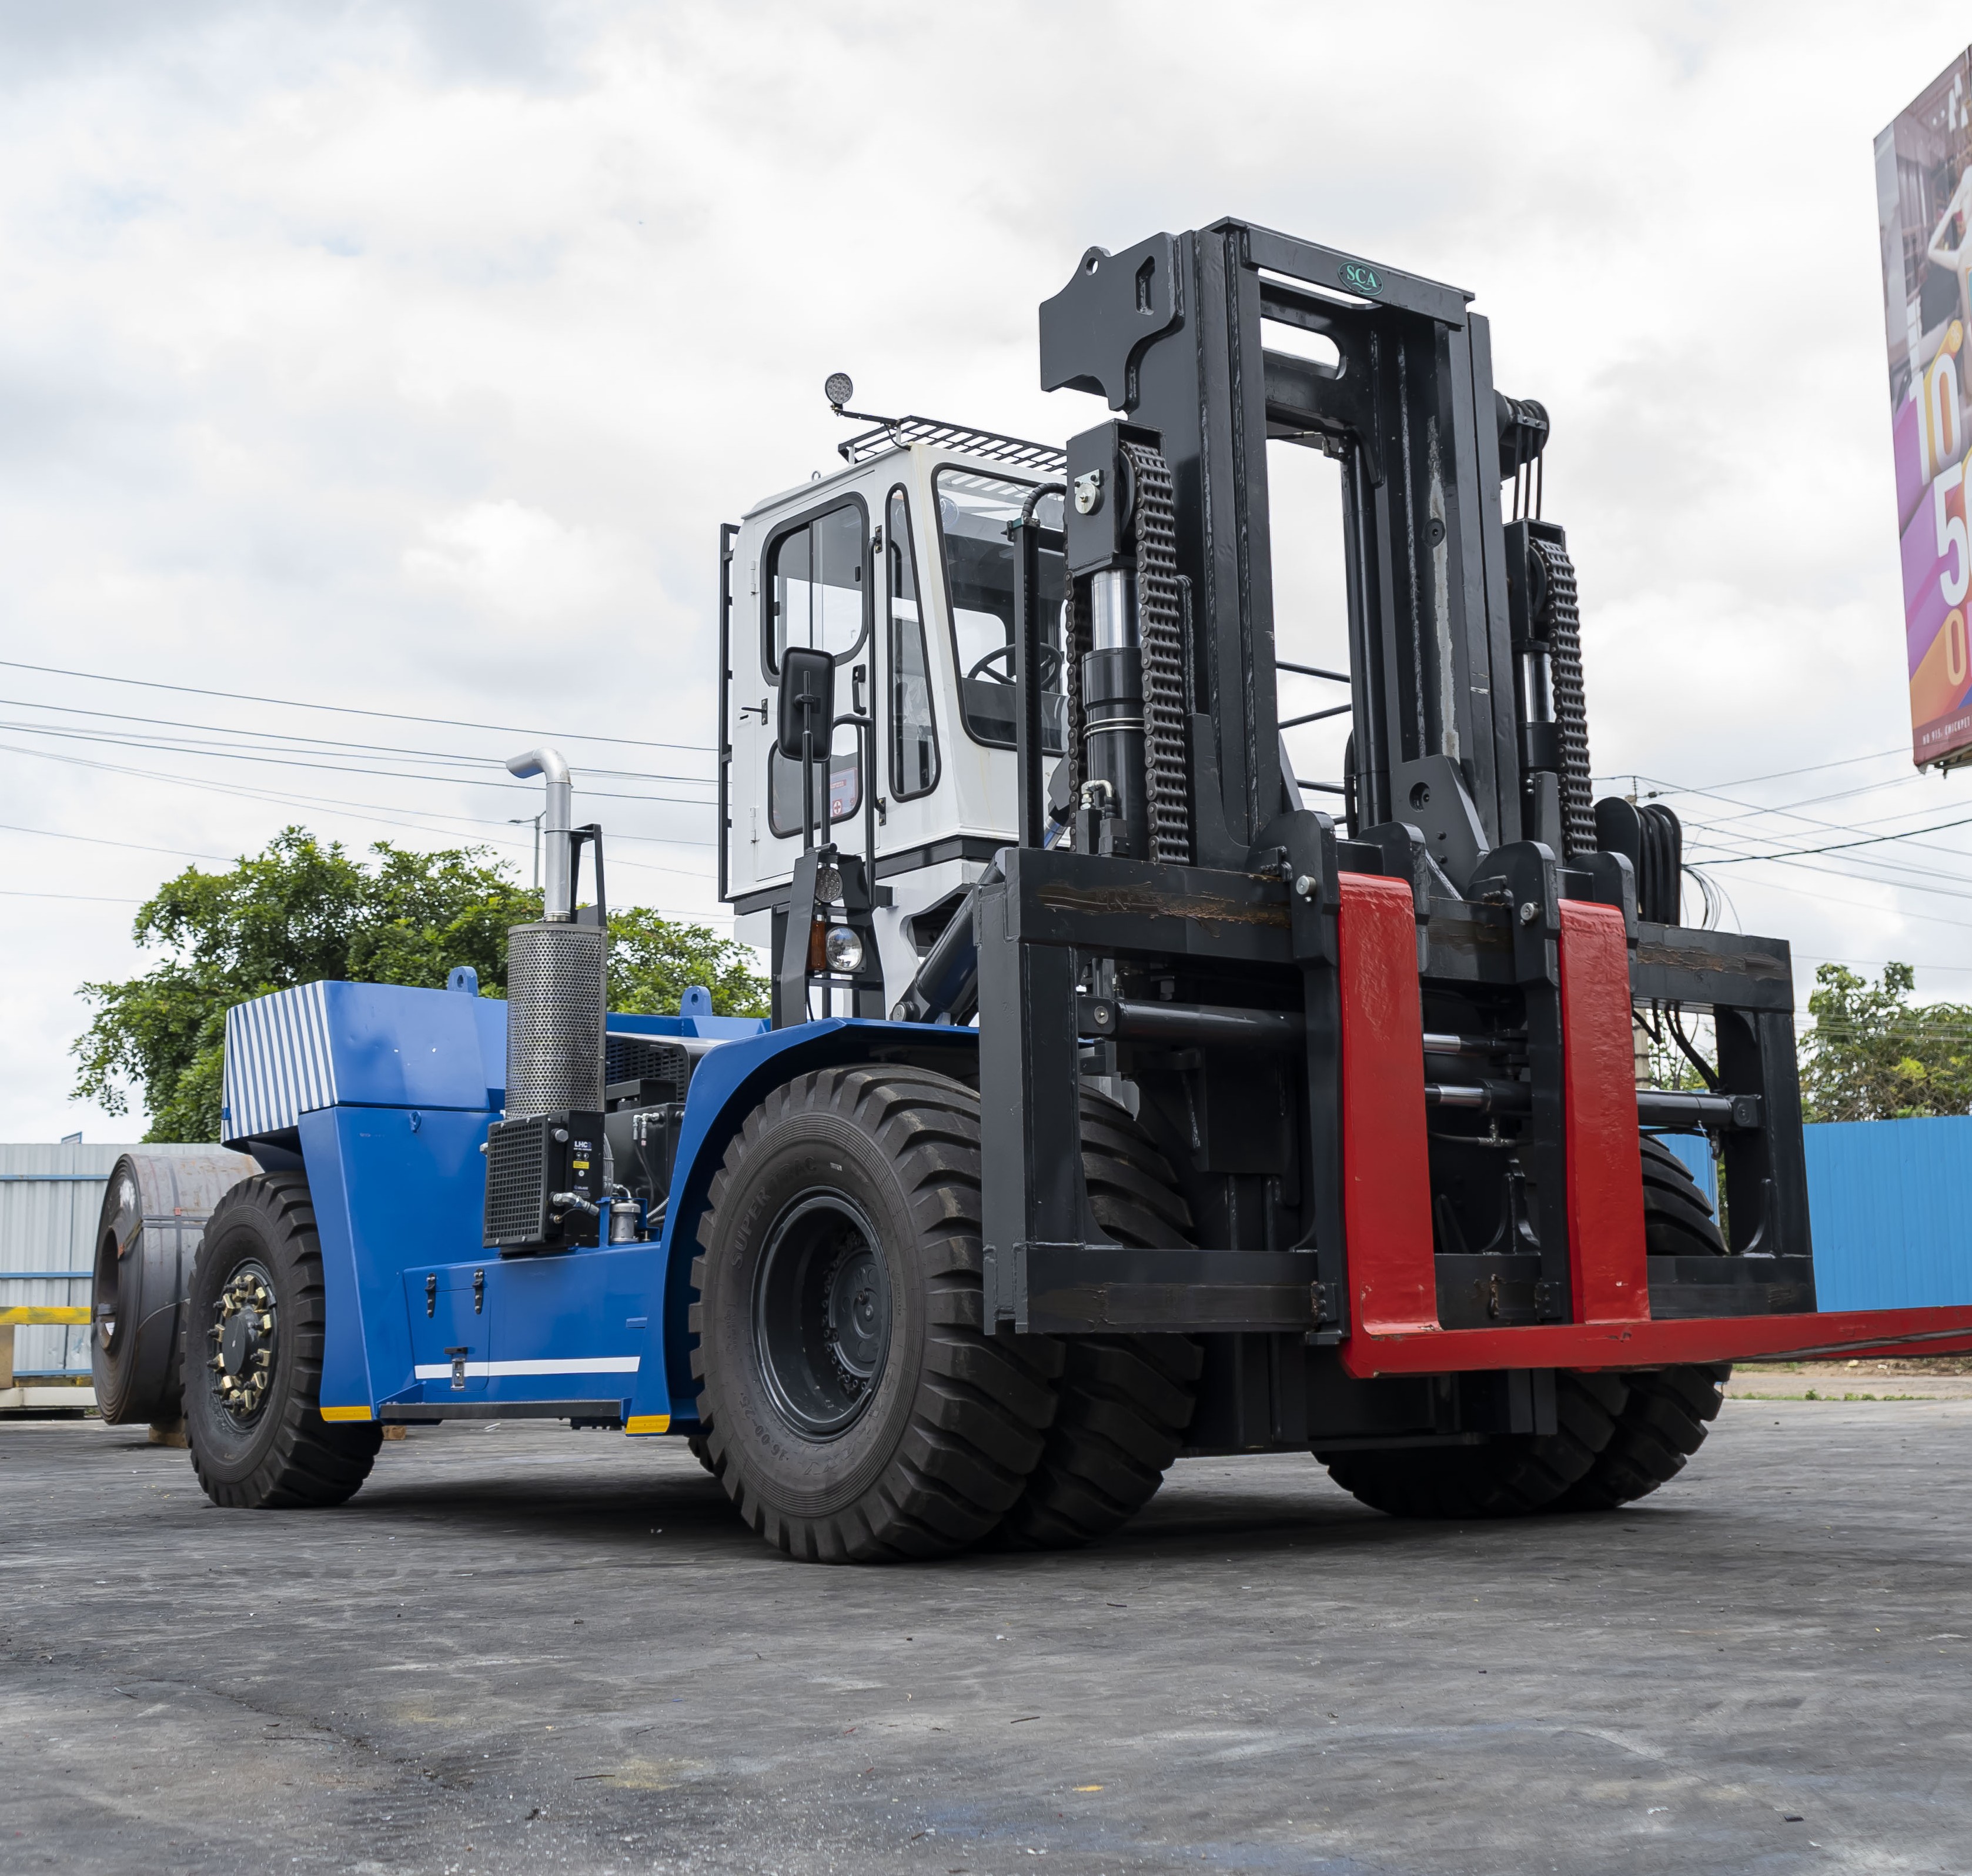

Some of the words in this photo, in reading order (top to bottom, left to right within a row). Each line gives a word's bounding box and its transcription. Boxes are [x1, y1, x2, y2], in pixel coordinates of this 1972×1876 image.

[1346, 265, 1377, 288] SCA
[1909, 353, 1961, 486] 10
[730, 1186, 771, 1269] SUPER
[769, 1156, 818, 1184] TRAC
